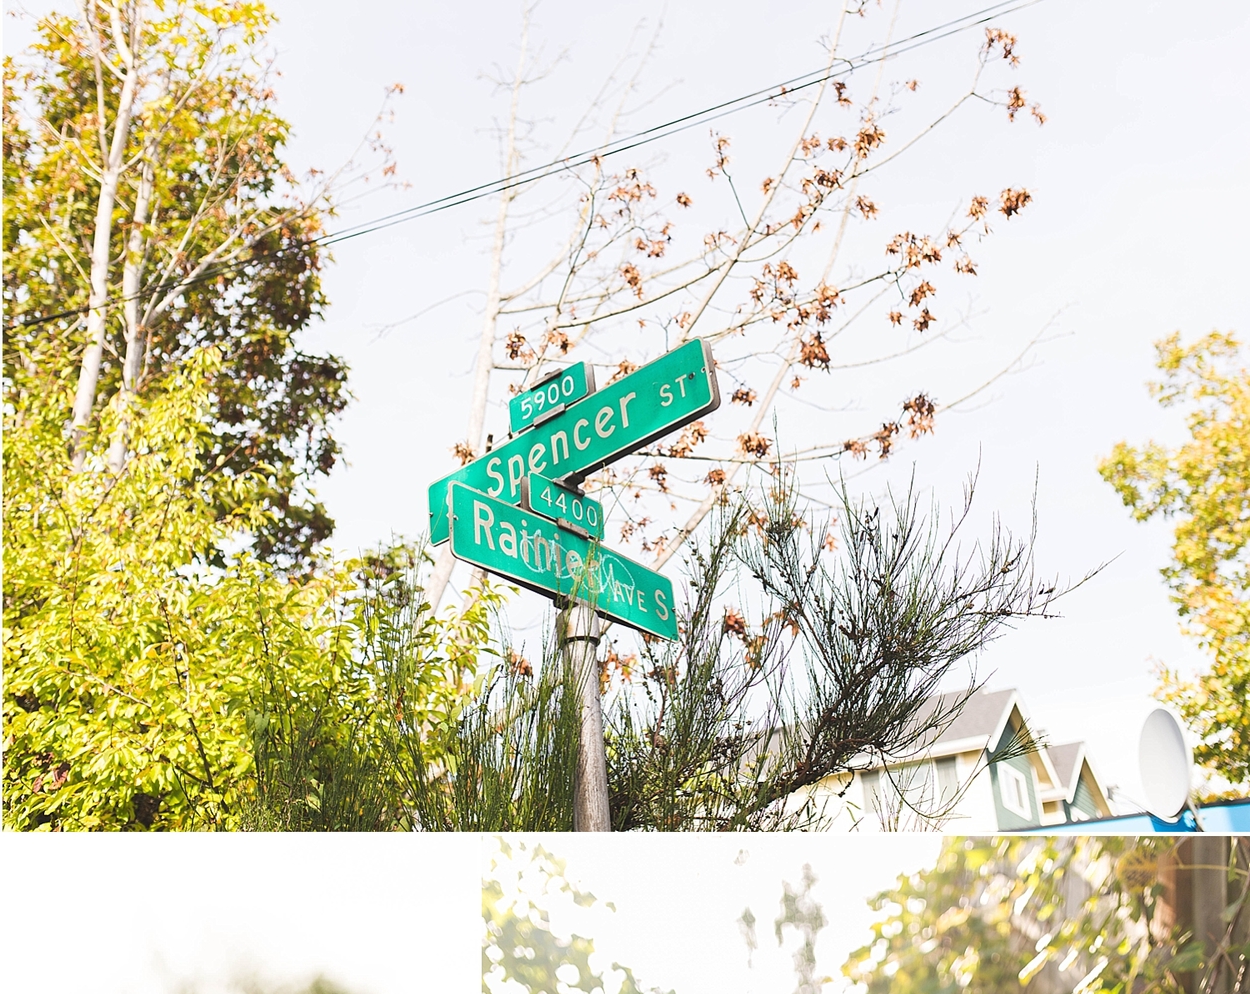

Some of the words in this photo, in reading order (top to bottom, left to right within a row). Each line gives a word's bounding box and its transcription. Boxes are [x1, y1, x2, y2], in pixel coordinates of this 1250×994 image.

[486, 391, 636, 498] Spencer
[658, 374, 687, 408] ST
[520, 375, 575, 420] 5900
[539, 486, 597, 527] 4400
[473, 499, 599, 588] Rainier
[614, 580, 648, 613] AVE
[654, 589, 670, 621] S
